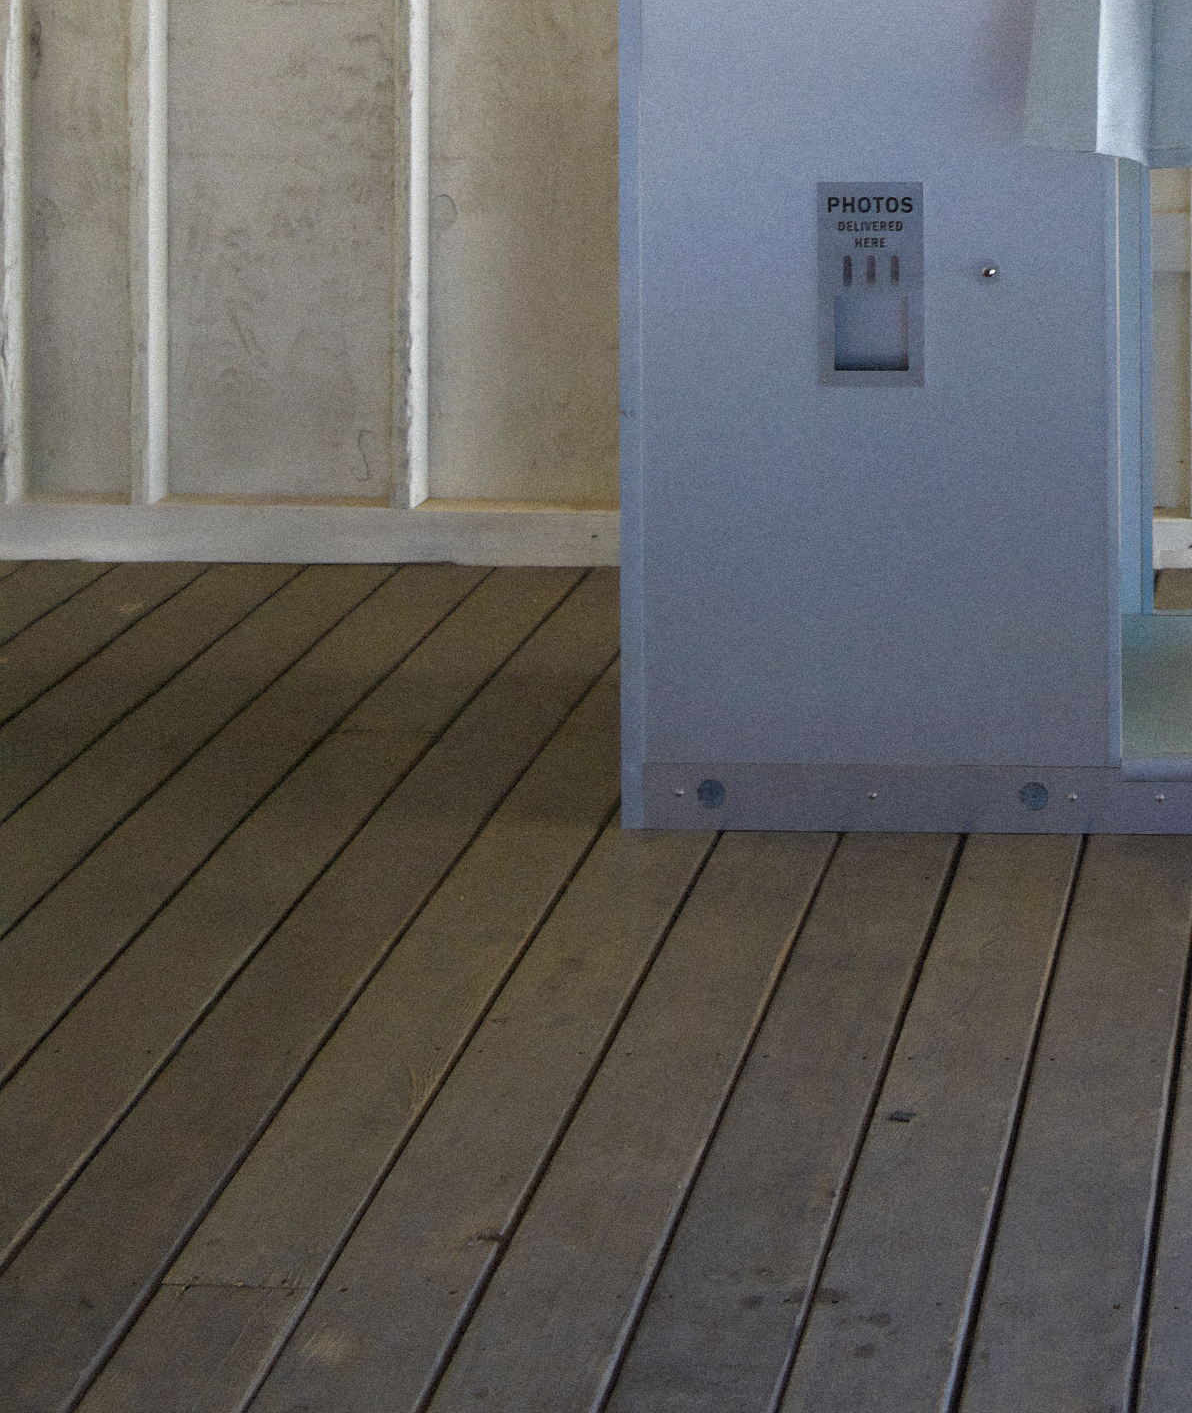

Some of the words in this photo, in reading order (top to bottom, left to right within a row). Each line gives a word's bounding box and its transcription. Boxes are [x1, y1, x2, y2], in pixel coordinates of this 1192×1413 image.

[827, 196, 914, 214] PHOTOS
[837, 220, 904, 232] DELIVERED
[854, 237, 886, 248] HERE
